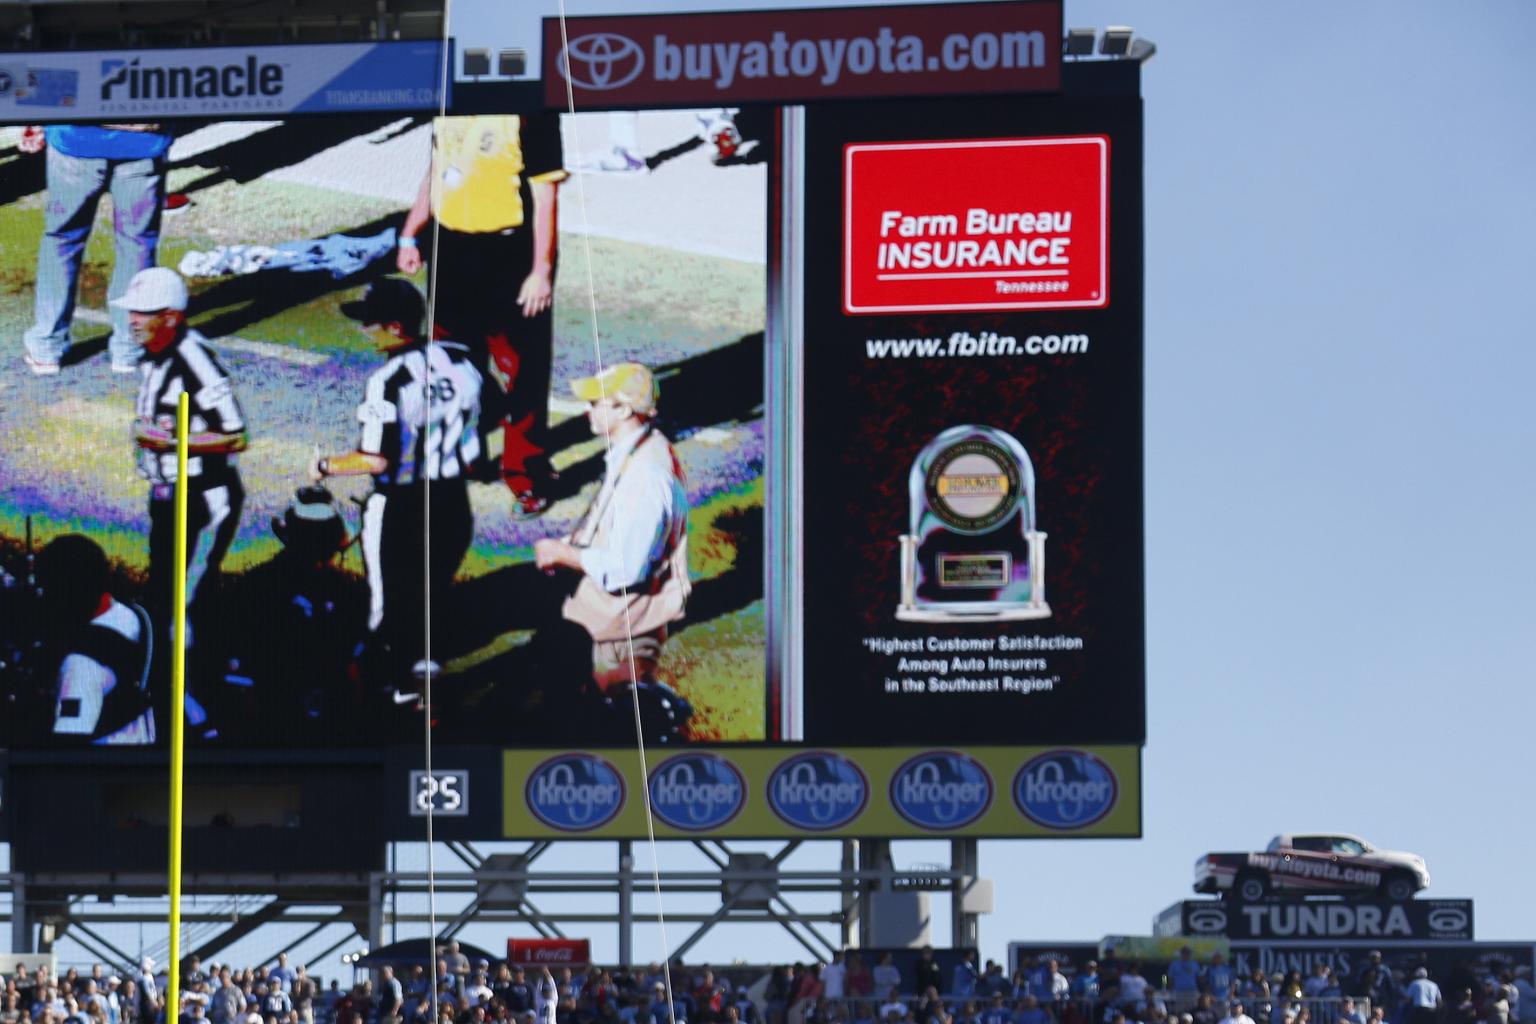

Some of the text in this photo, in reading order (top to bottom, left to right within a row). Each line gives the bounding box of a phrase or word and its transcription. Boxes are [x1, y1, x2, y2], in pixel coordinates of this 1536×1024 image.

[653, 28, 1045, 88] buyatoyota.com
[101, 54, 284, 101] Pinnacle
[880, 208, 1072, 238] Farm Bureau
[877, 237, 1071, 270] INSURANCE
[994, 280, 1070, 294] Tennessee
[865, 332, 1089, 358] www.fbitn.com
[926, 636, 996, 651] Customer
[998, 635, 1084, 651] Satisfaction
[897, 656, 1047, 674] Among Auto Insurers
[885, 678, 899, 693] in
[902, 678, 926, 692] the
[928, 677, 1000, 692] Southeast
[416, 775, 461, 810] 25
[538, 764, 618, 822] Kroger
[659, 764, 739, 822] Kroger
[779, 762, 860, 821] Kroger
[903, 762, 985, 821] Kroger
[1027, 762, 1109, 821] Kroger
[1241, 905, 1412, 935] TUNDRA
